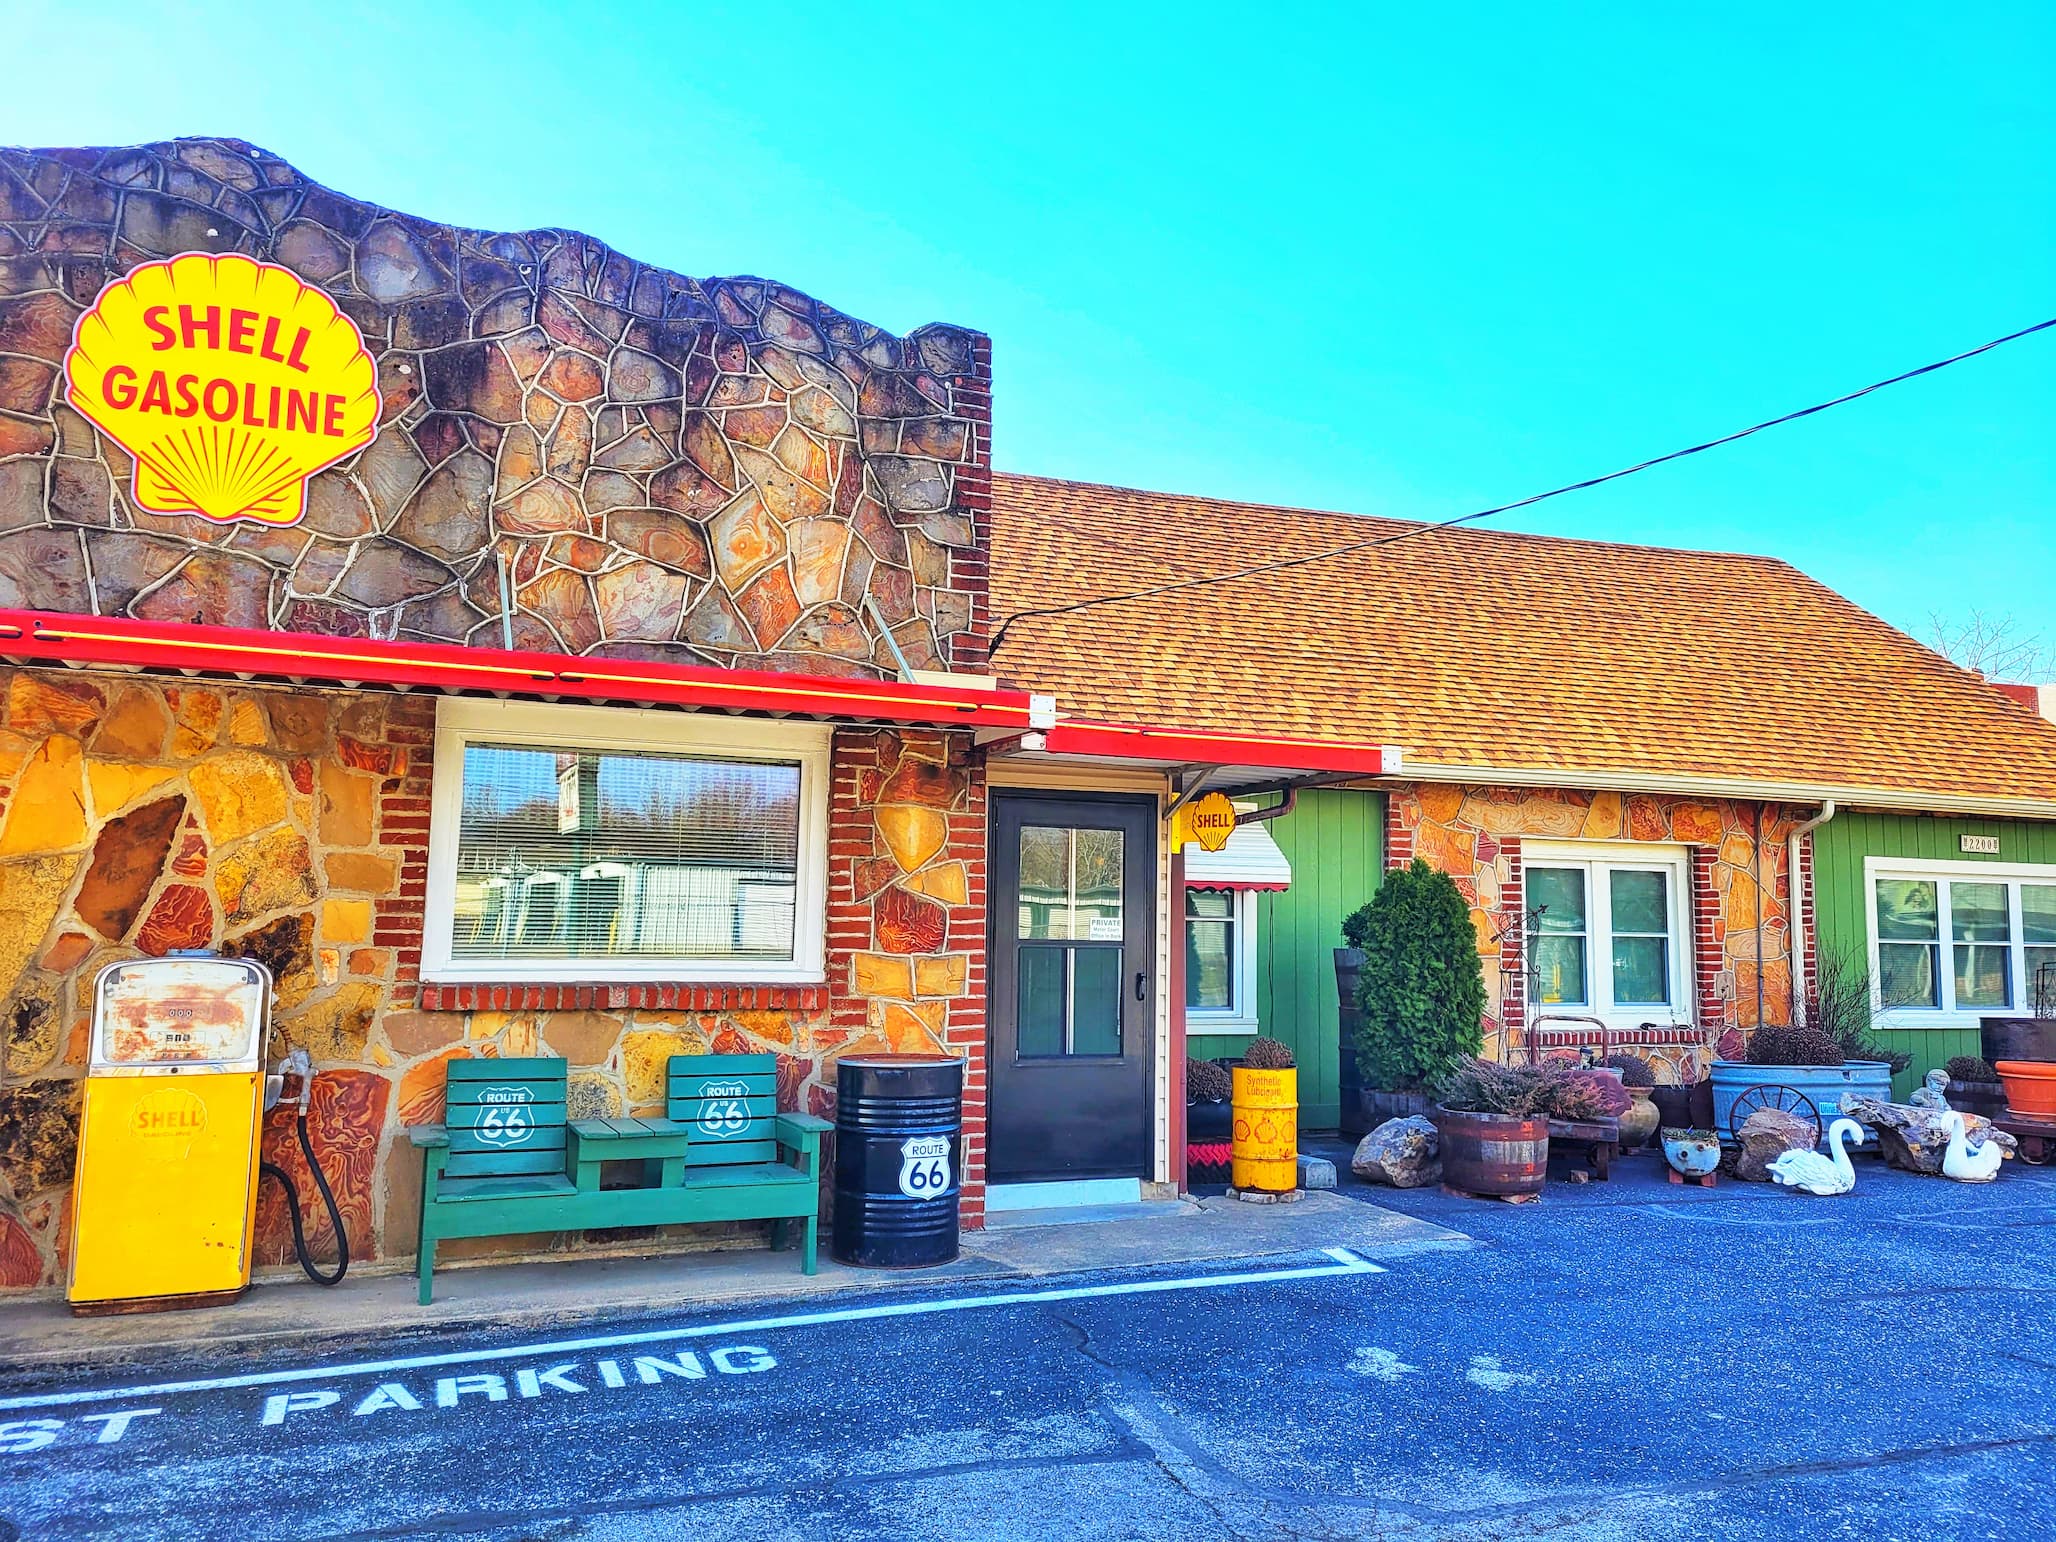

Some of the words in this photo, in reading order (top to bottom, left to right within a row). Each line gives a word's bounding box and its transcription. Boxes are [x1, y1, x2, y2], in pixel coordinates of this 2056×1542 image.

[143, 304, 311, 373] SHELL
[102, 365, 346, 437] GASOLINE
[1197, 813, 1230, 828] SHELL
[1969, 838, 1992, 850] 2200
[1091, 919, 1121, 927] PRIVATE
[486, 1093, 525, 1104] ROUTE
[706, 1087, 742, 1097] ROUTE
[138, 1110, 200, 1129] SHELL
[482, 1108, 526, 1138] 66
[704, 1101, 744, 1130] 66
[912, 1144, 944, 1155] ROUTE
[909, 1160, 944, 1190] 66
[262, 1346, 778, 1426] PARKING
